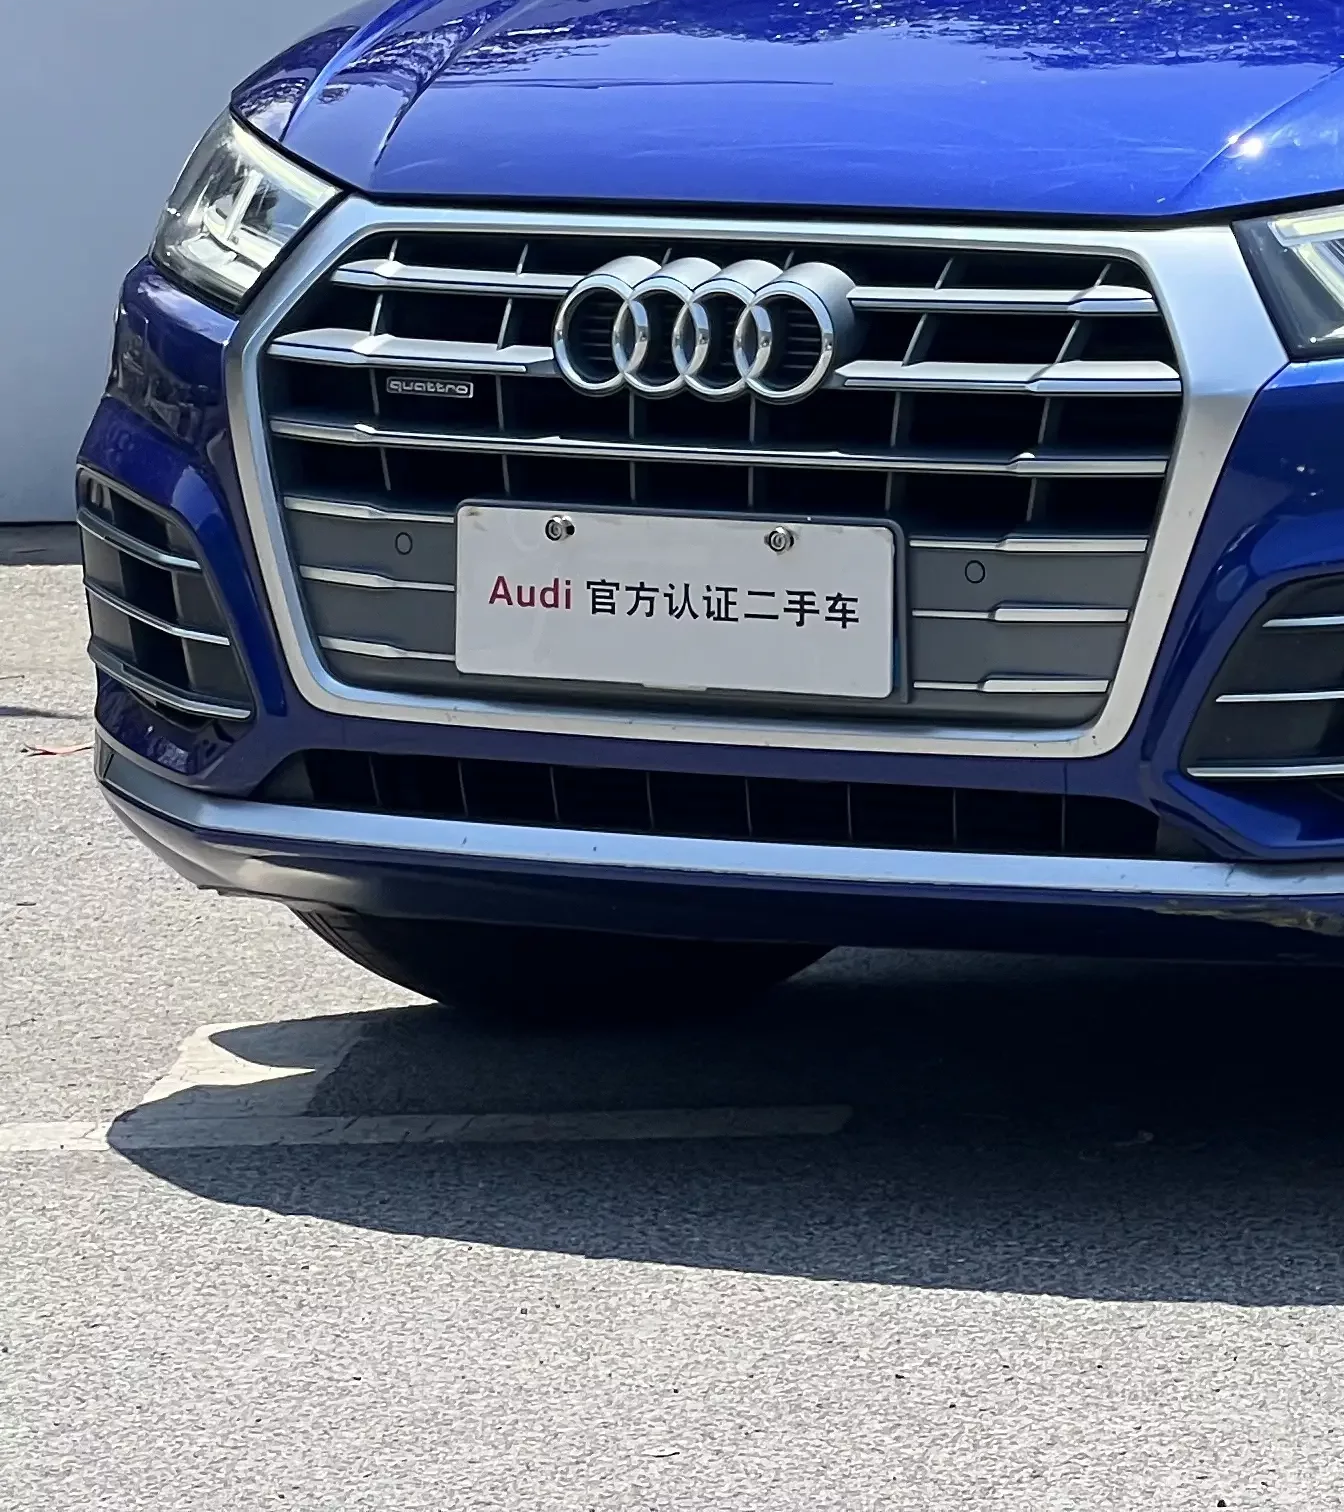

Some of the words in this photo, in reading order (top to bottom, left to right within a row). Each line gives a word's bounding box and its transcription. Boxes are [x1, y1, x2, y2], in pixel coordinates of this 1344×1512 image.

[389, 380, 469, 394] quattro
[488, 575, 572, 610] Audi
[586, 578, 860, 629] 官方认证二手车
